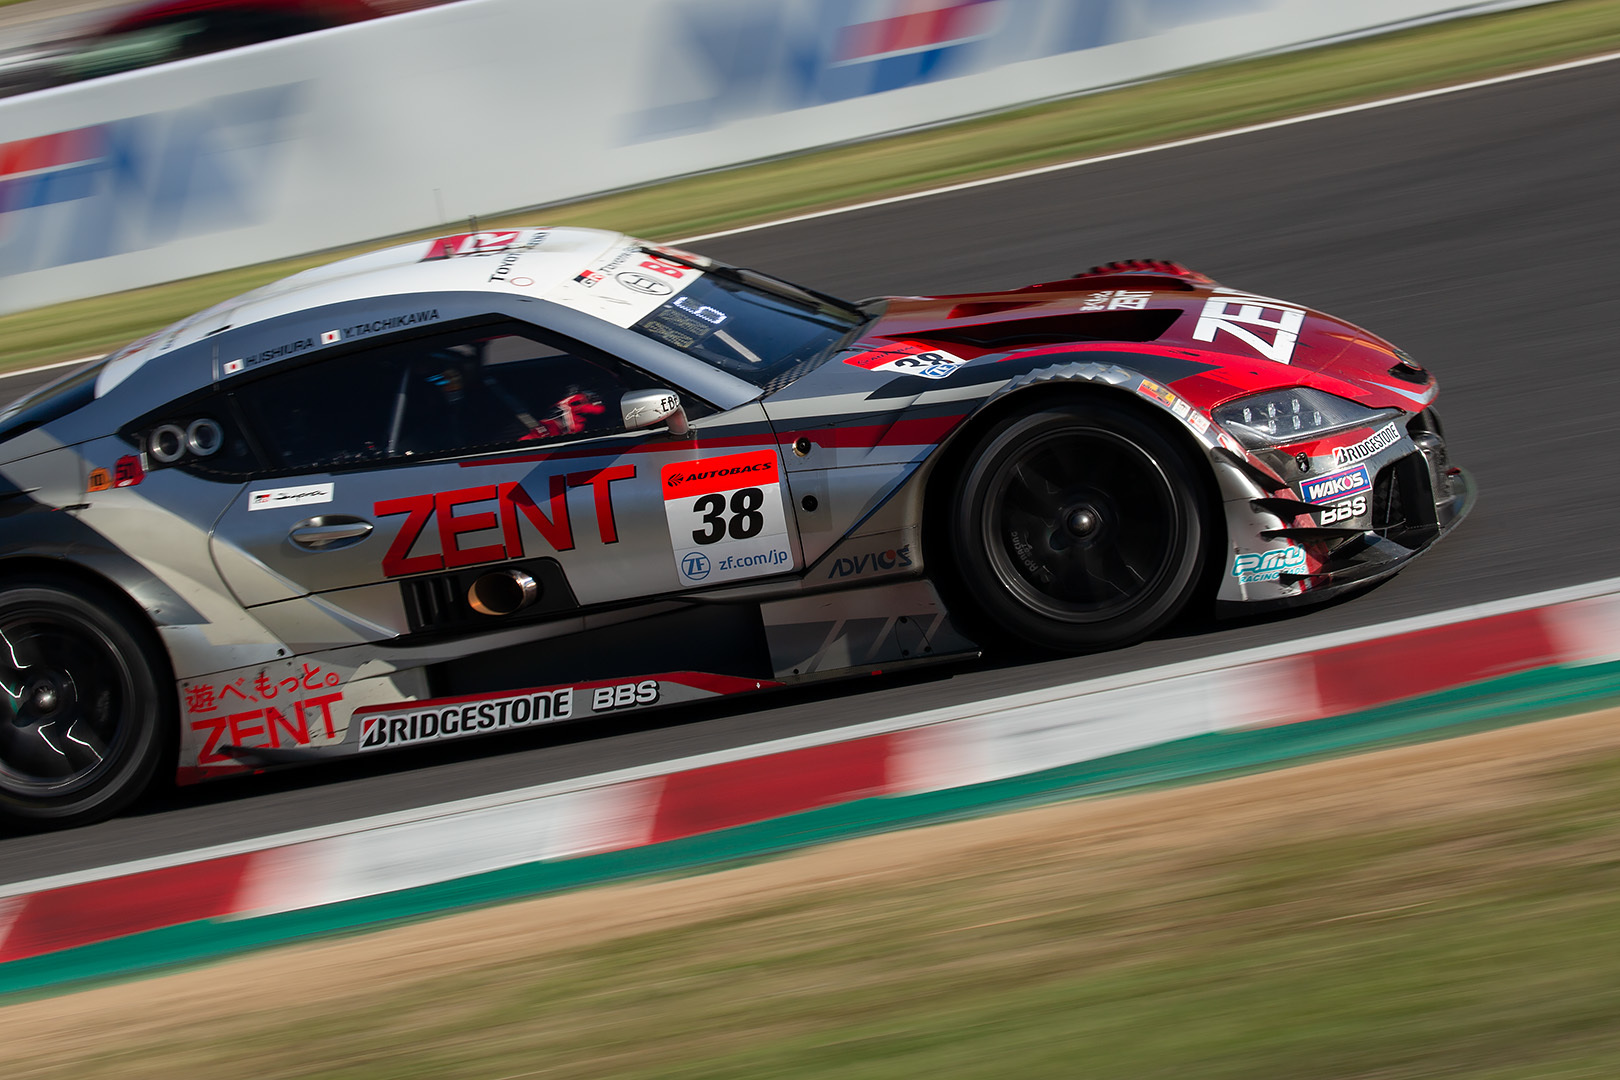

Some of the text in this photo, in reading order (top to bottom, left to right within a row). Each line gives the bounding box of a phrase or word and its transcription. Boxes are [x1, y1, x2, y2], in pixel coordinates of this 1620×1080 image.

[343, 308, 441, 339] Y.TACHIKAWA
[1335, 423, 1400, 465] BRIDGESTONE
[685, 462, 772, 482] AUTOBACS
[373, 463, 637, 579] ZENT
[692, 487, 764, 546] 38
[1320, 496, 1367, 526] BBS
[682, 549, 788, 578] ZF zf.com/jp
[828, 544, 913, 579] ADVICS
[1240, 573, 1280, 584] RACING
[184, 662, 340, 713] 遊べ、もっと。
[191, 691, 344, 766] ZENT
[360, 680, 660, 749] BRIDGESTONE BBS
